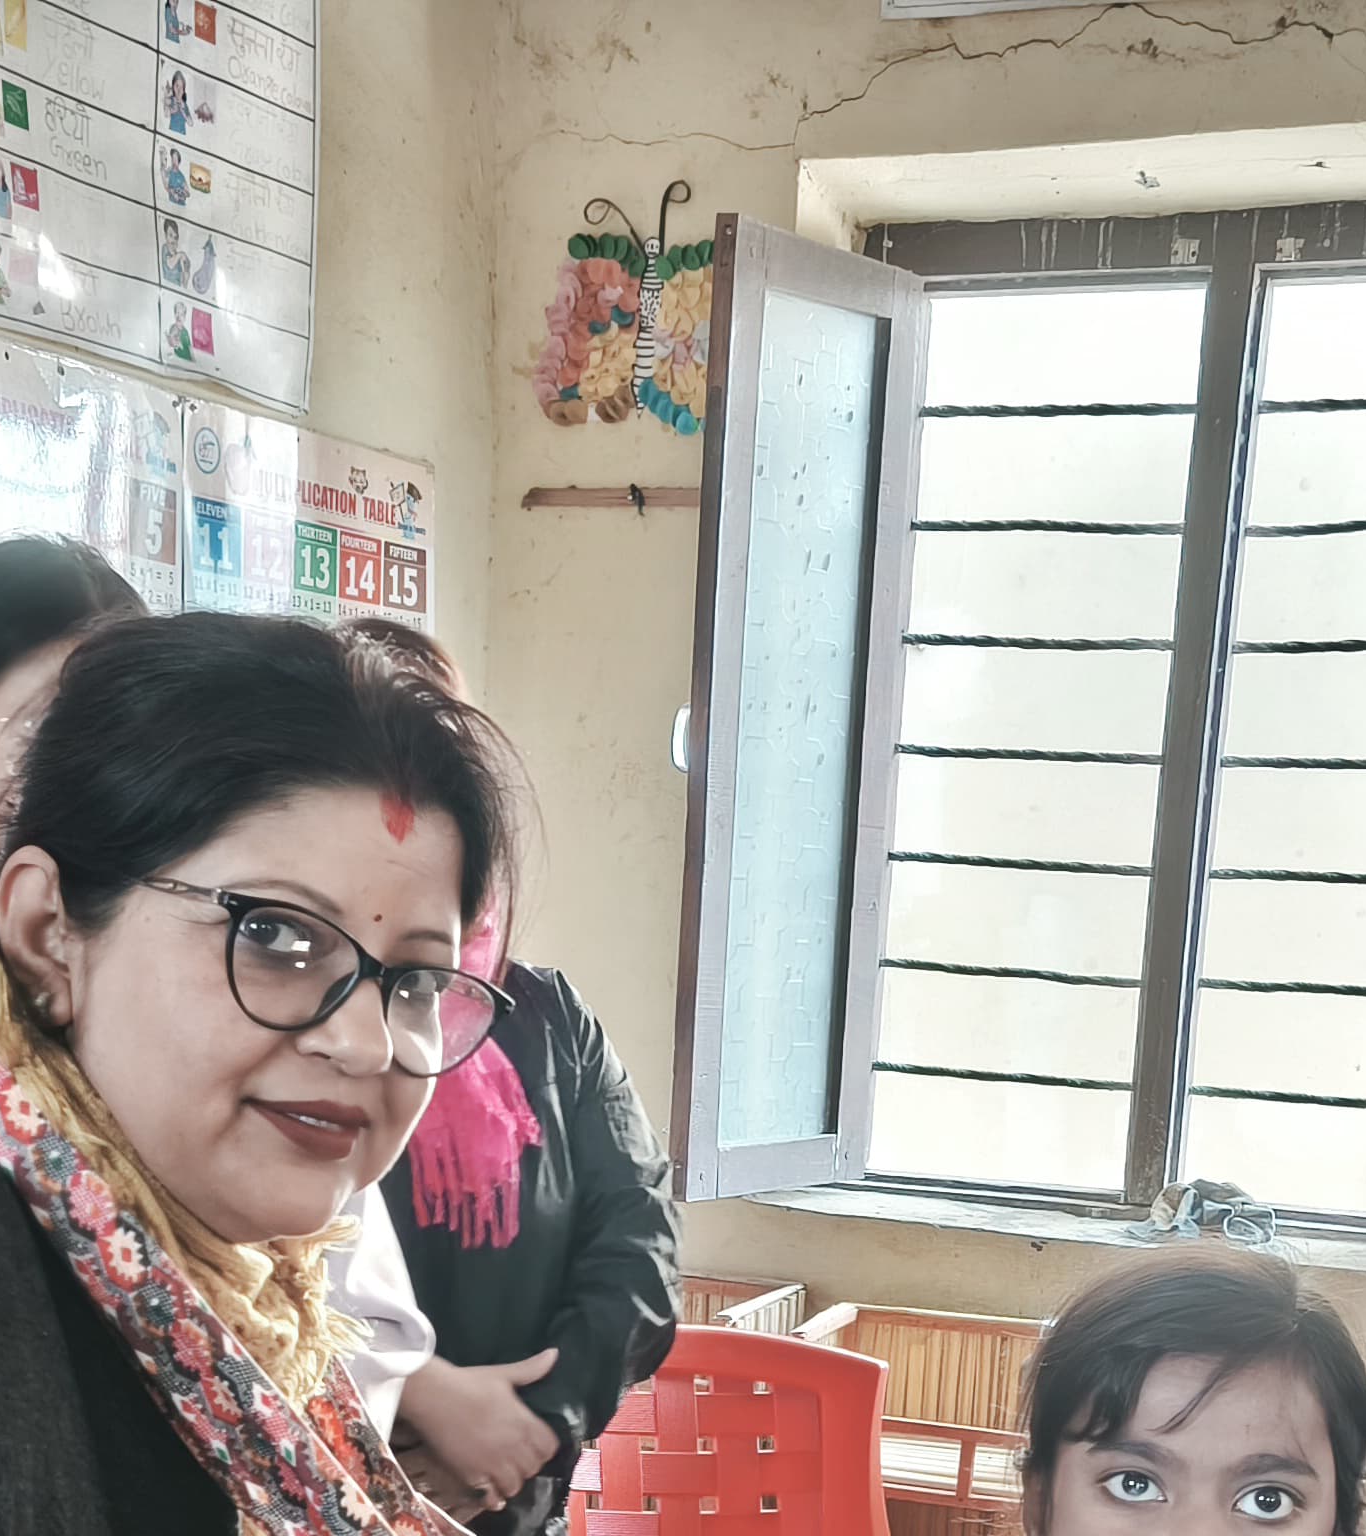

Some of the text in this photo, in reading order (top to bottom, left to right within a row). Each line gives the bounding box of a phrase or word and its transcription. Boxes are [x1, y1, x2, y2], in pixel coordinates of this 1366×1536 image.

[139, 484, 166, 507] FIVE
[196, 501, 228, 519] ELEVEN
[362, 496, 397, 526] TABLE
[144, 508, 163, 555] 5
[299, 545, 331, 590] 13
[345, 556, 376, 600] 14
[388, 564, 419, 607] 15
